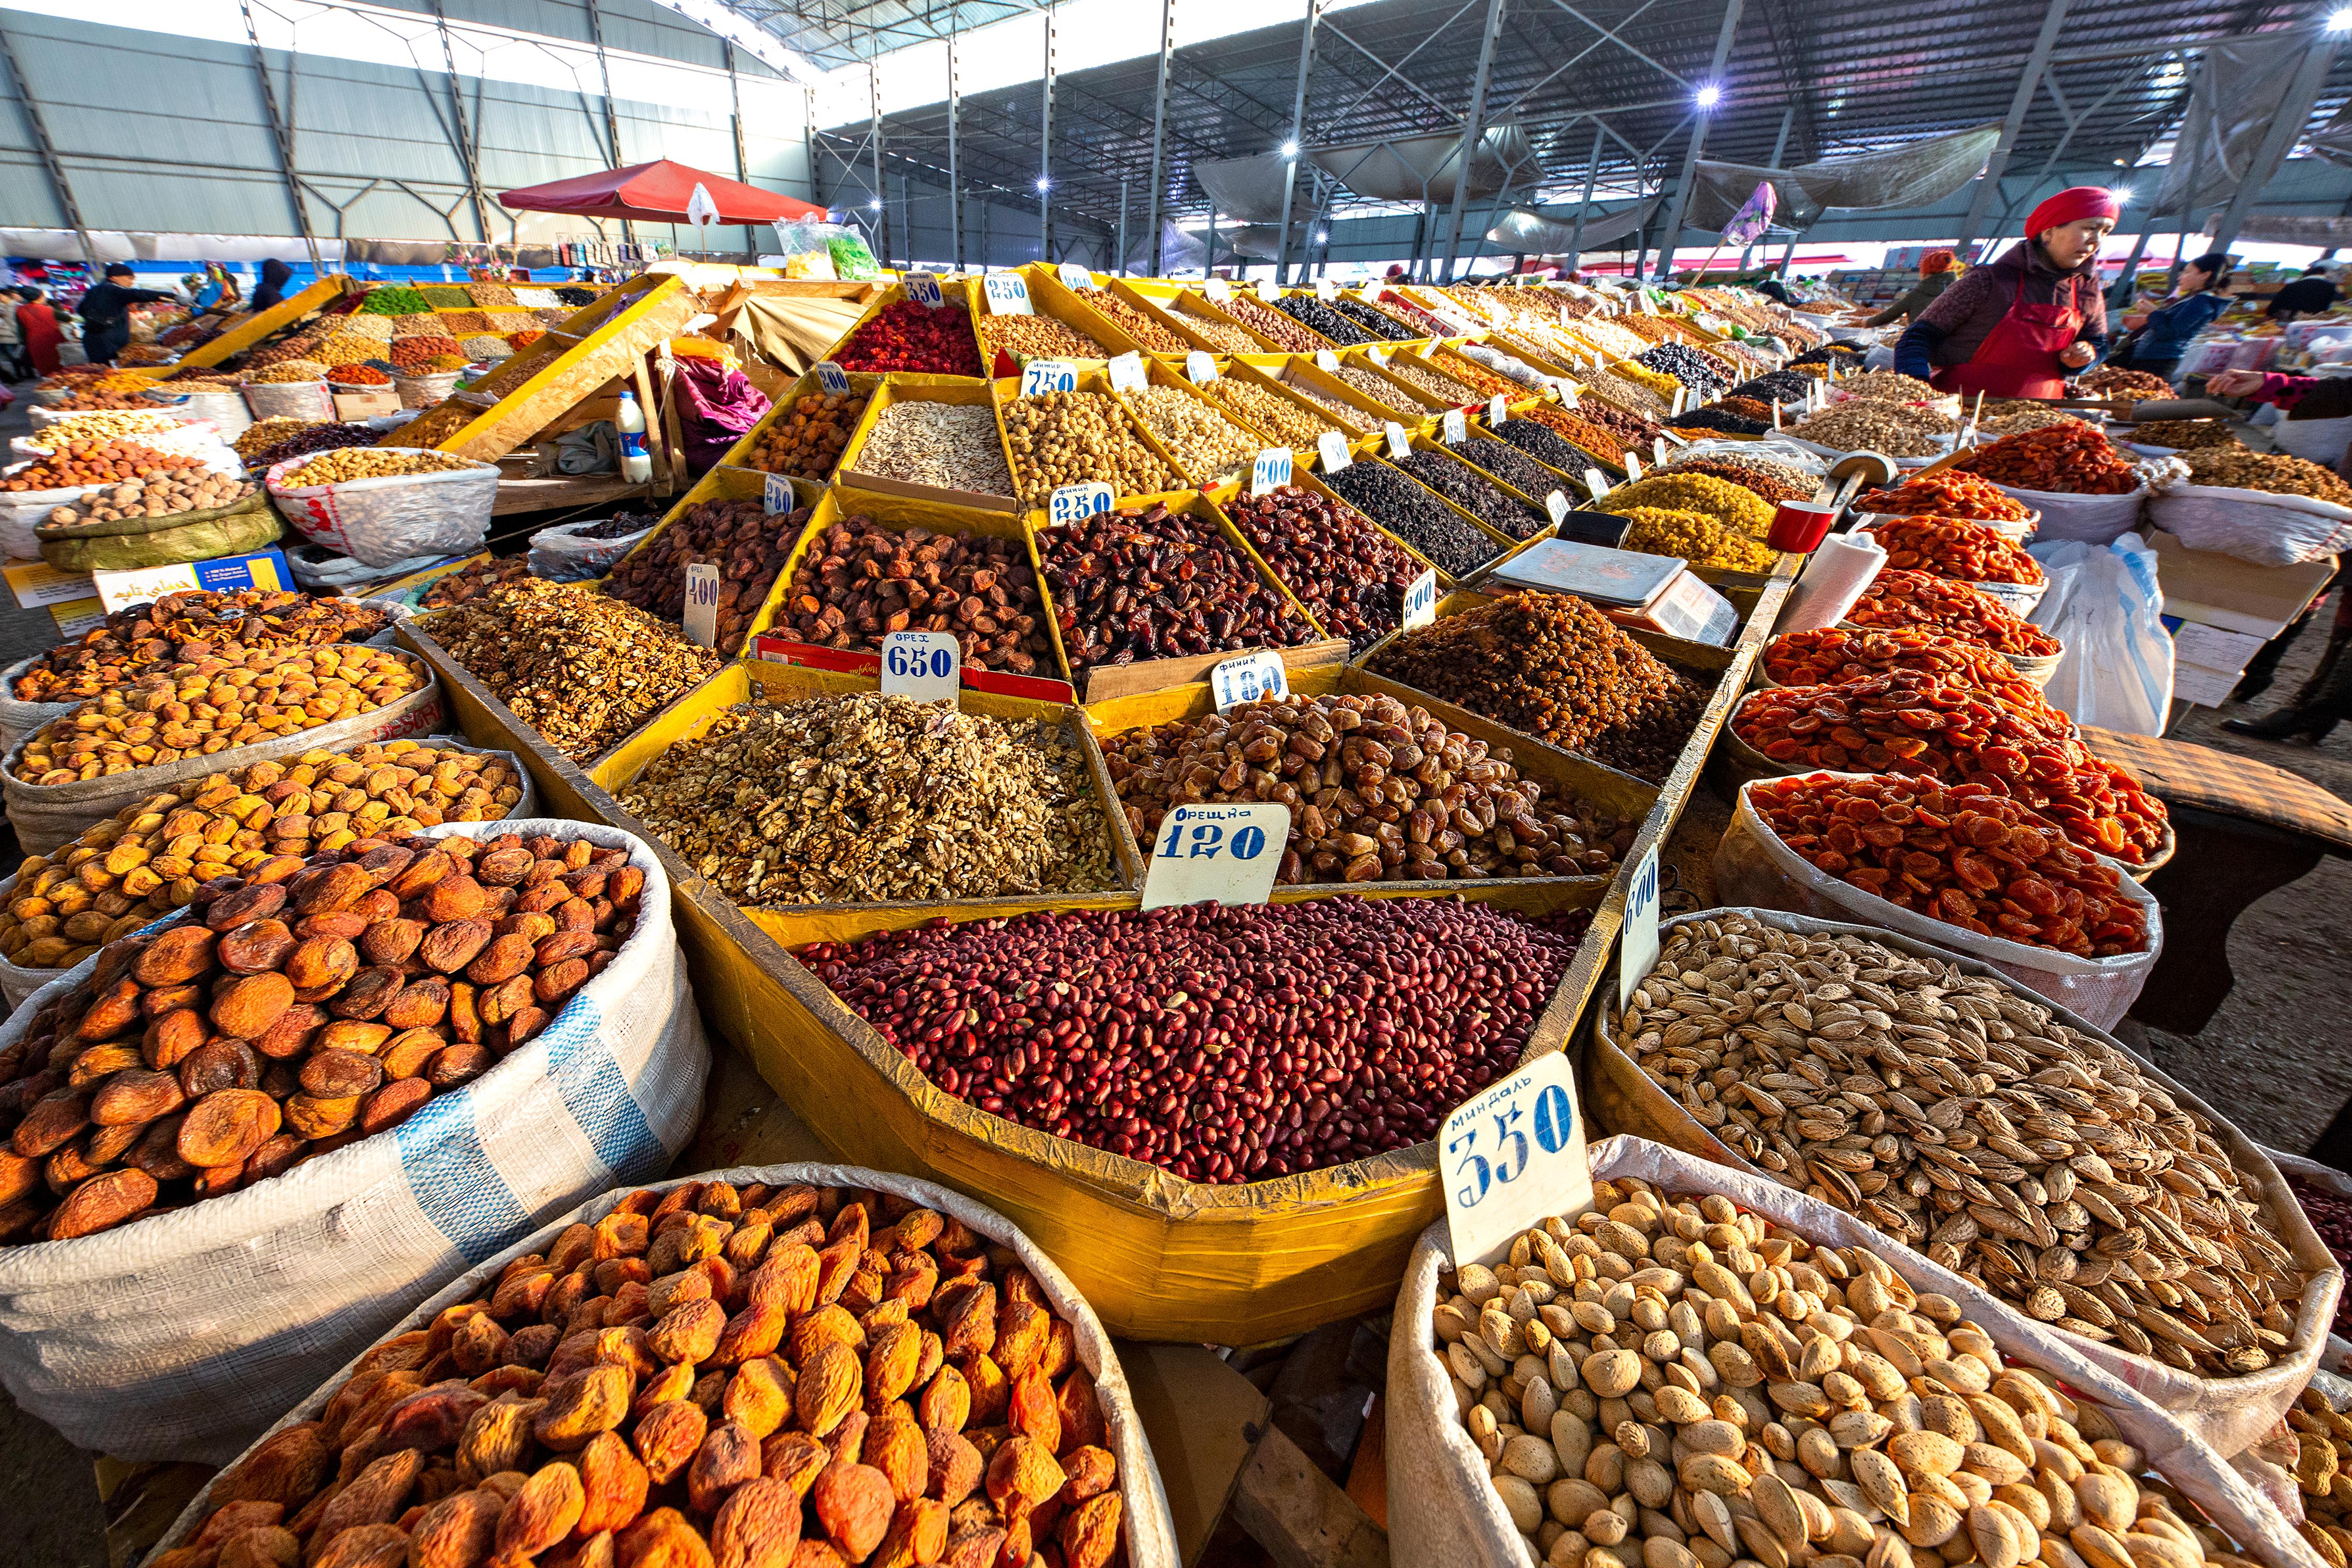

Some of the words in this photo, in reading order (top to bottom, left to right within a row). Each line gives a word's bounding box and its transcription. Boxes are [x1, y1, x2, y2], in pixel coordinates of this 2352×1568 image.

[905, 282, 940, 302] 350
[988, 280, 1025, 299] 250
[818, 370, 847, 389] 200
[1028, 370, 1074, 396] 750
[1388, 431, 1406, 447] 650
[1448, 421, 1465, 444] 650
[1257, 458, 1290, 486] 200
[767, 482, 790, 514] 280
[1054, 492, 1110, 522] 250
[689, 576, 718, 606] 400
[1405, 581, 1432, 622] 200
[888, 646, 951, 678] 650
[1222, 666, 1281, 705] 180
[1157, 825, 1266, 860] 120
[1625, 861, 1655, 935] 600
[1449, 1085, 1572, 1209] 350
